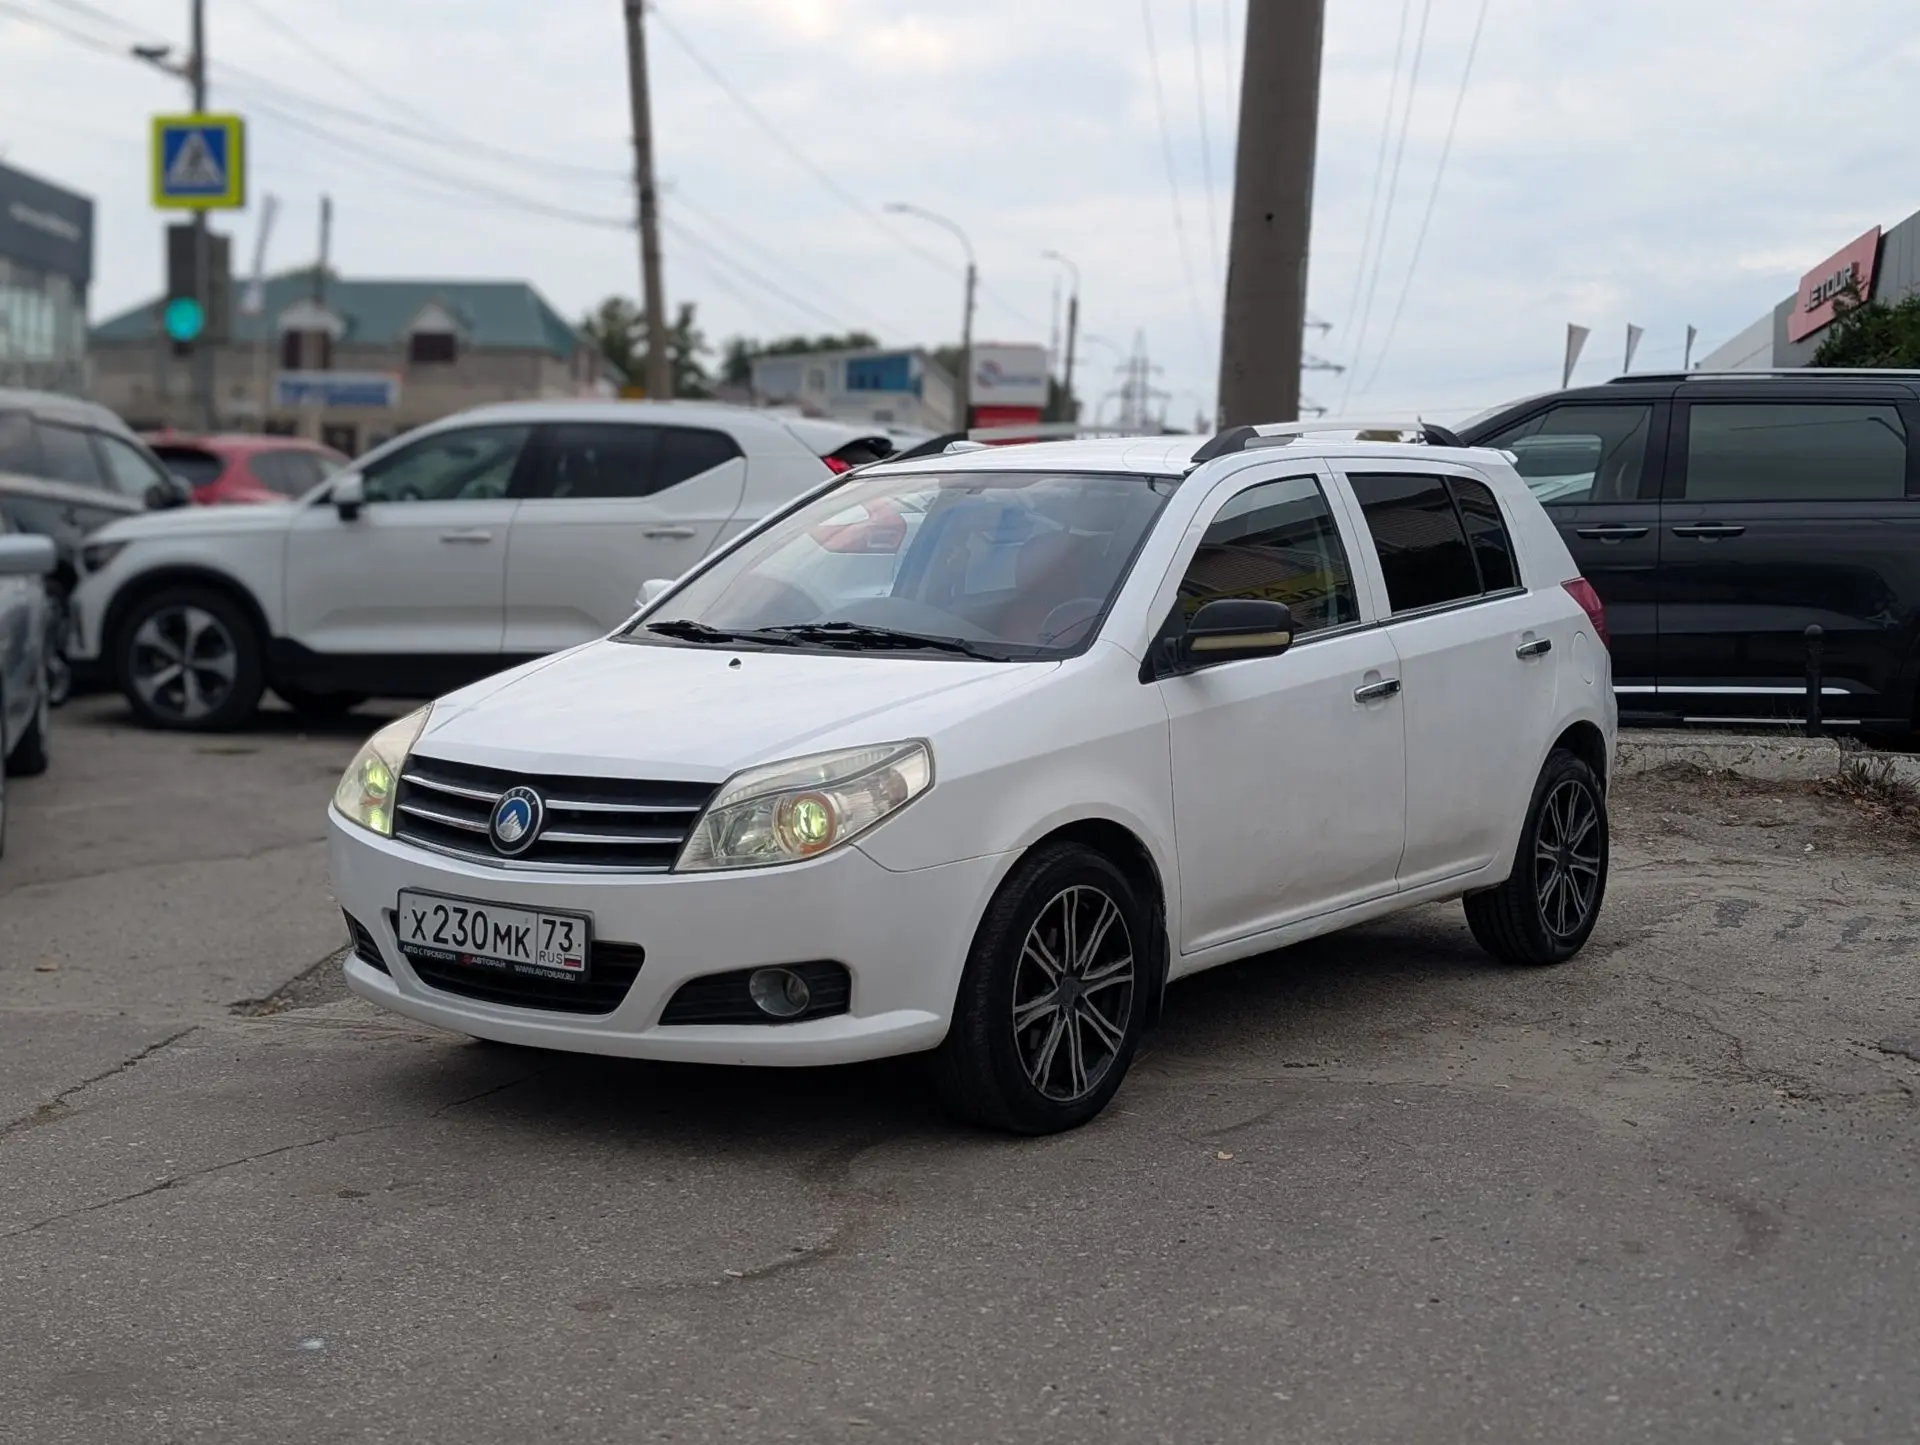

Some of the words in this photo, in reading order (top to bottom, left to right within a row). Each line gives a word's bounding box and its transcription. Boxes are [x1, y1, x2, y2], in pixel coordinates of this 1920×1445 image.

[1804, 262, 1853, 311] JETOUR
[411, 904, 531, 959] Х230МК
[542, 918, 573, 953] 73
[539, 950, 563, 965] RUS
